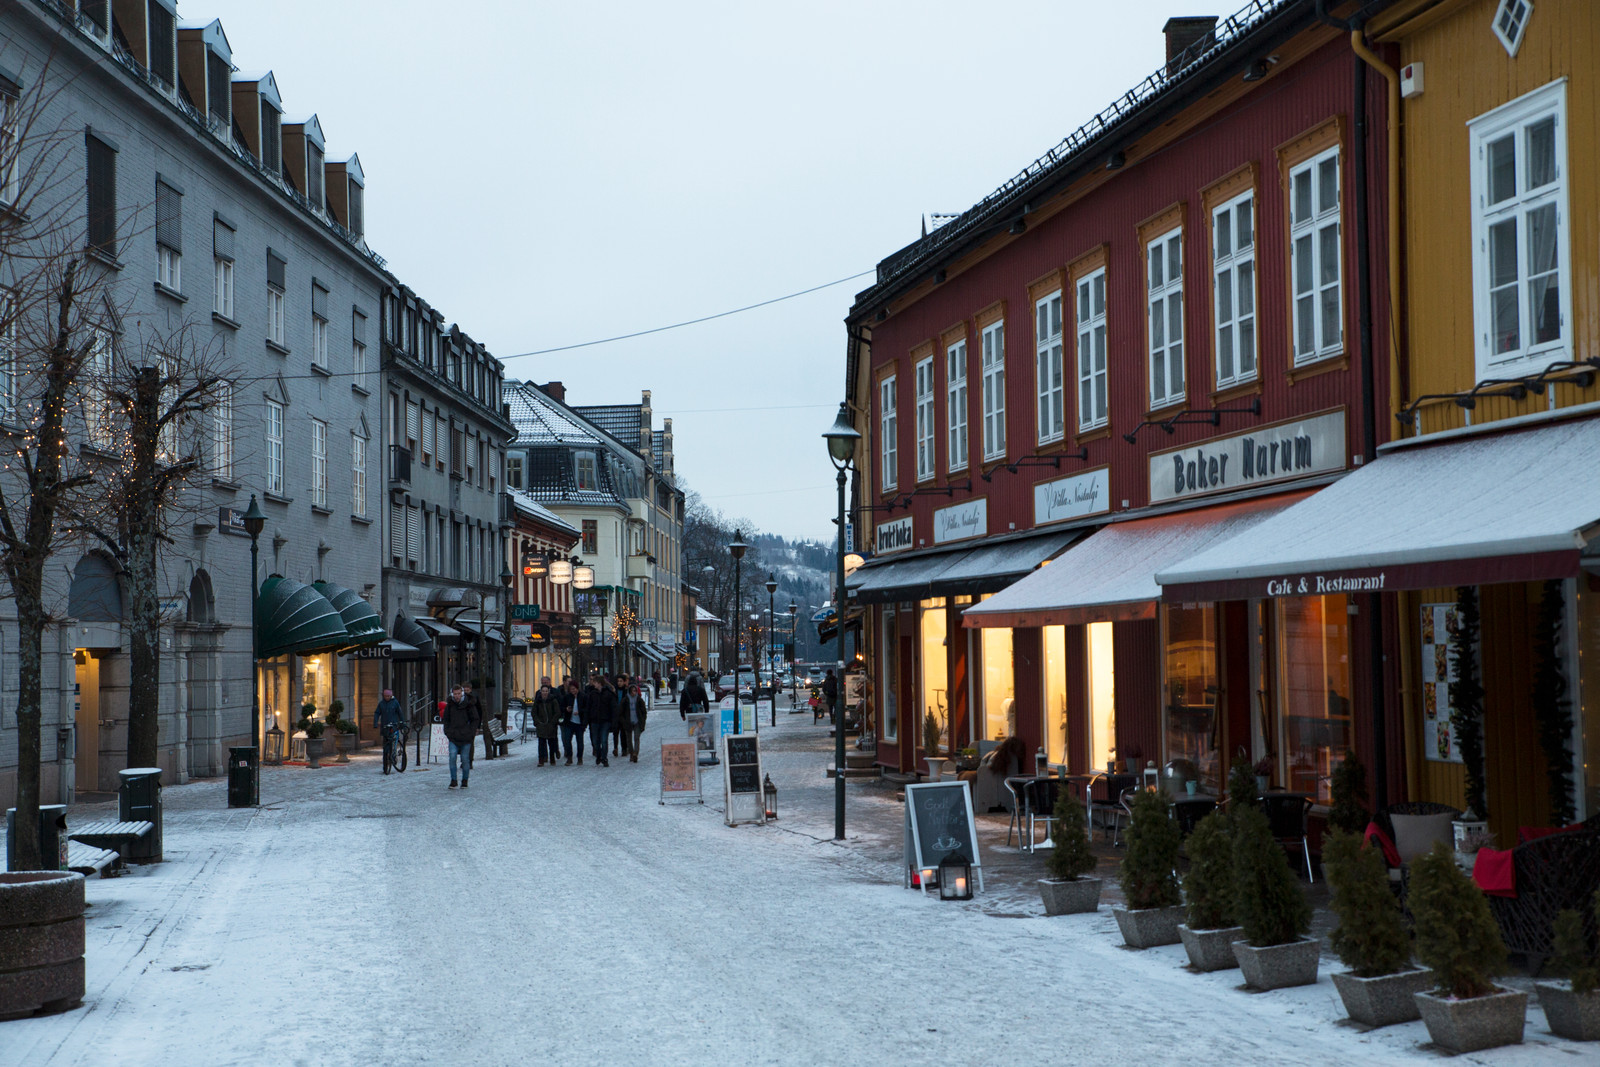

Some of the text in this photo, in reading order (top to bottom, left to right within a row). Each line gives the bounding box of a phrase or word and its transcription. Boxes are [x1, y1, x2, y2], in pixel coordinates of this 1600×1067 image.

[1173, 434, 1312, 493] Baker Narum
[1297, 577, 1309, 593] &
[1316, 571, 1386, 593] Restaurant
[514, 605, 537, 619] DNB
[359, 647, 390, 658] CHIC
